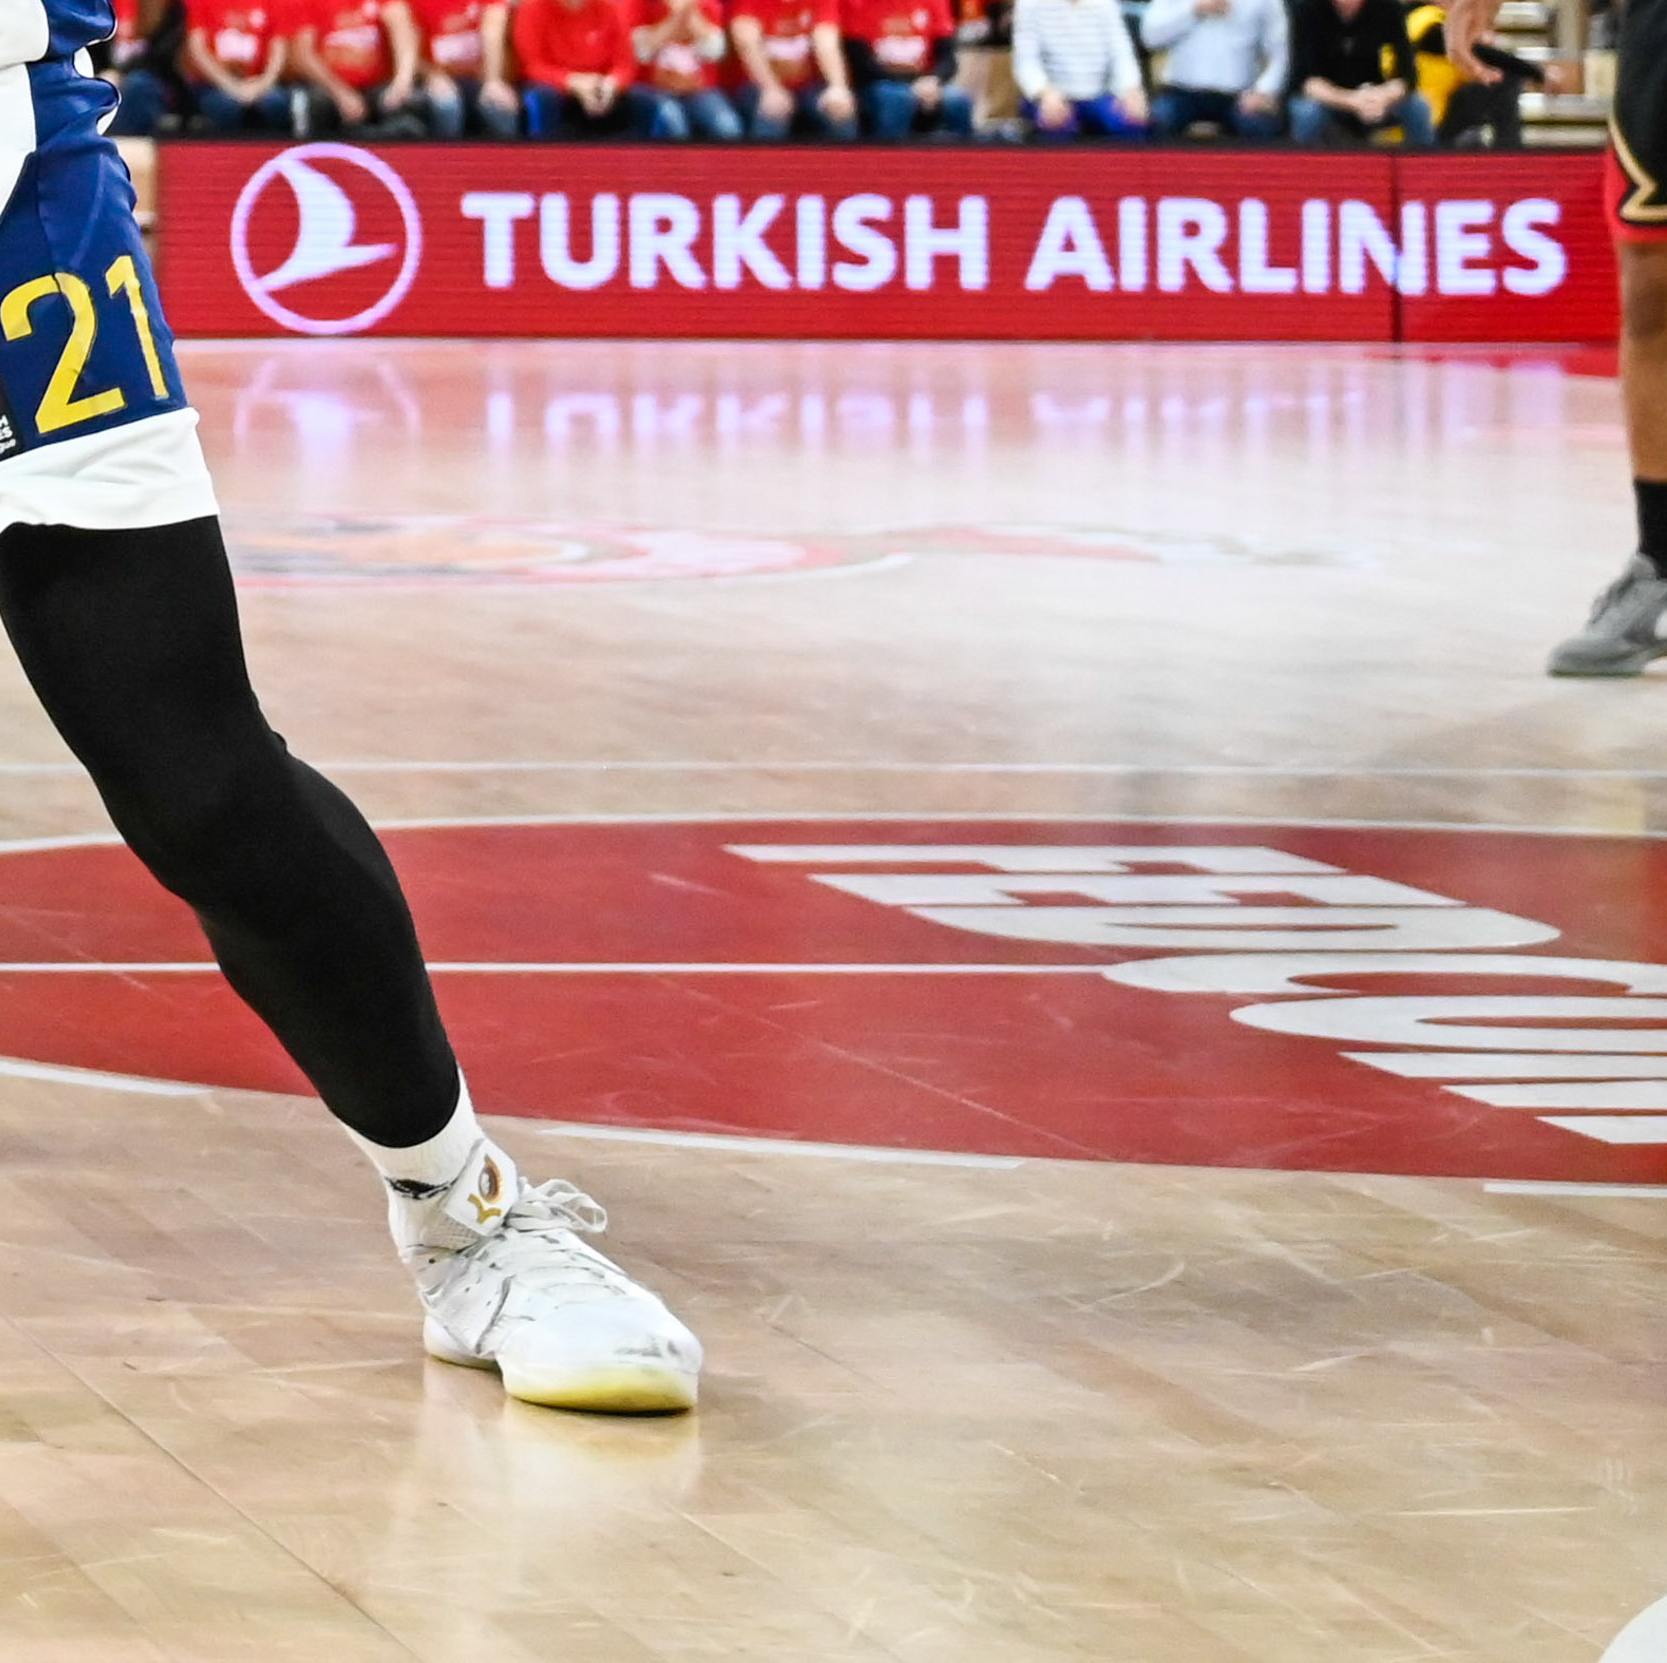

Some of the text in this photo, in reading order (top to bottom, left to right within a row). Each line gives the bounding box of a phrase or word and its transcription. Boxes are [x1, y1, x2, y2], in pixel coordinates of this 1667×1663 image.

[461, 191, 1568, 297] TURKISH AIRLINES
[0, 254, 170, 435] 21
